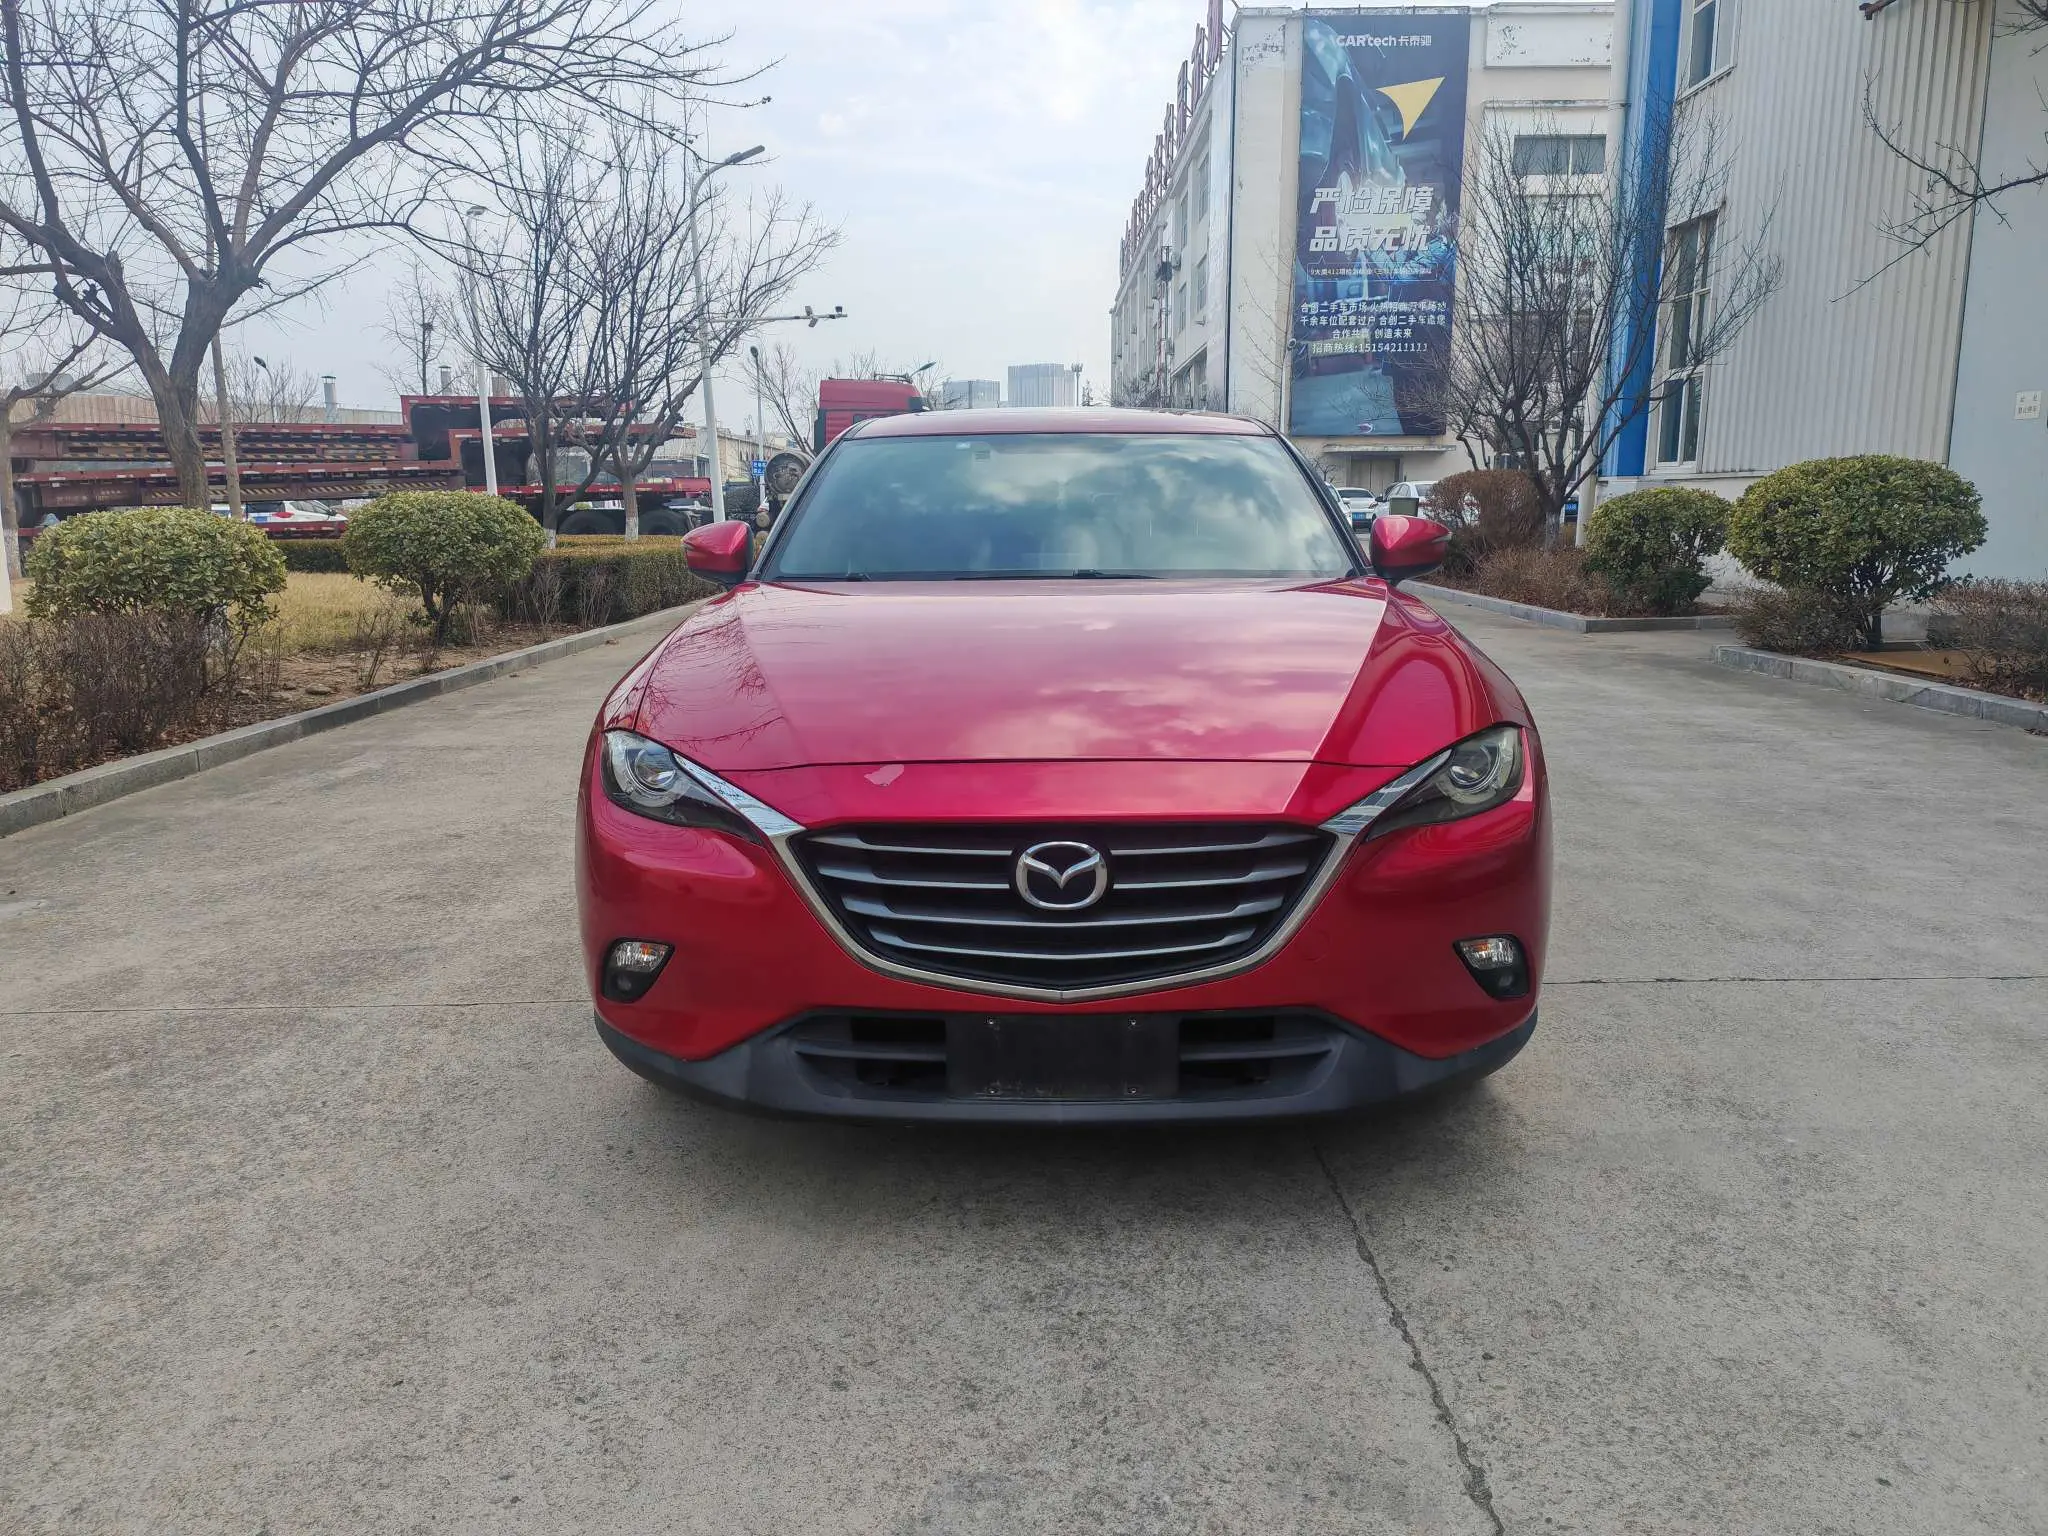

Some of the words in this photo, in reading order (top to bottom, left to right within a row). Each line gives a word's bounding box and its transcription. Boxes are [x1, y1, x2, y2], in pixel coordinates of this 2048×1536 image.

[1336, 34, 1397, 47] CARtech
[1309, 186, 1434, 214] 严检保障
[1309, 224, 1432, 252] 品质无忧
[1300, 315, 1376, 326] 千余车位配套过户
[1374, 328, 1412, 339] 创造未来
